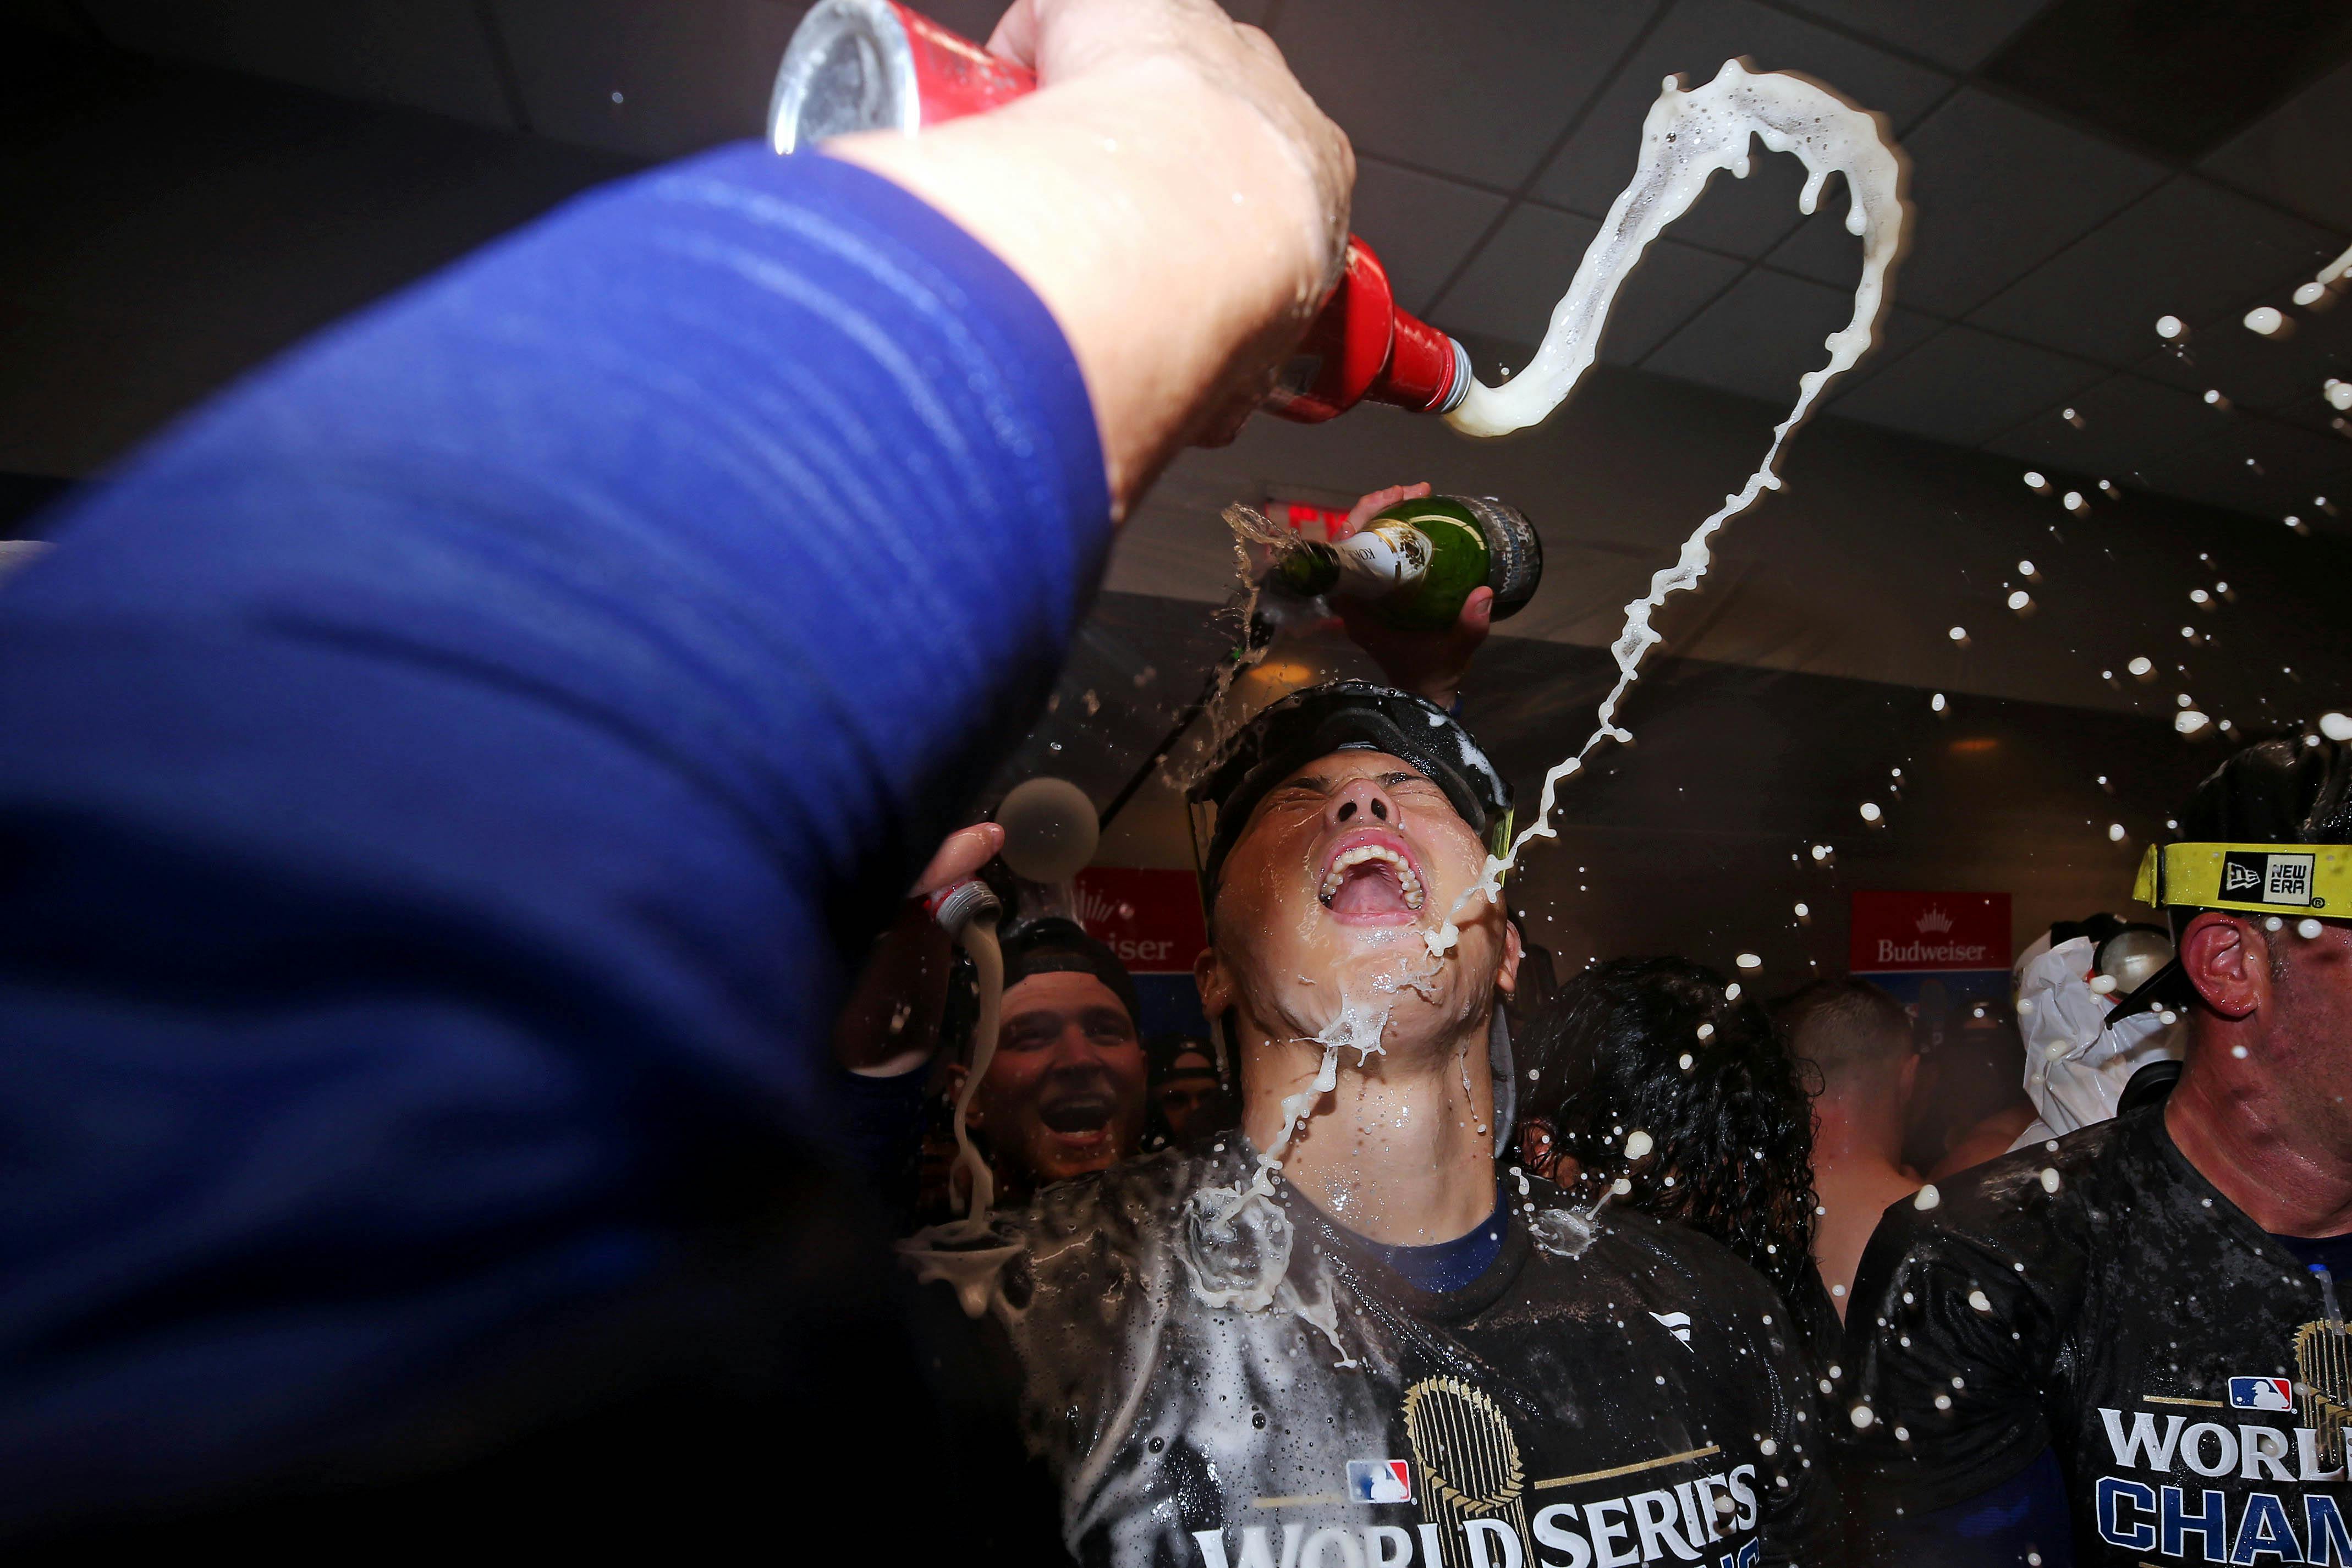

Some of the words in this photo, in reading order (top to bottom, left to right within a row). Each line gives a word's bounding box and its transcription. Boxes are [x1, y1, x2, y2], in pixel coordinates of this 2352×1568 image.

[2271, 864, 2306, 879] NEW
[2270, 879, 2305, 895] ERA
[1877, 938, 1987, 962] Budweiser
[2097, 1407, 2352, 1483] WORL
[1532, 1464, 1757, 1568] SERIES
